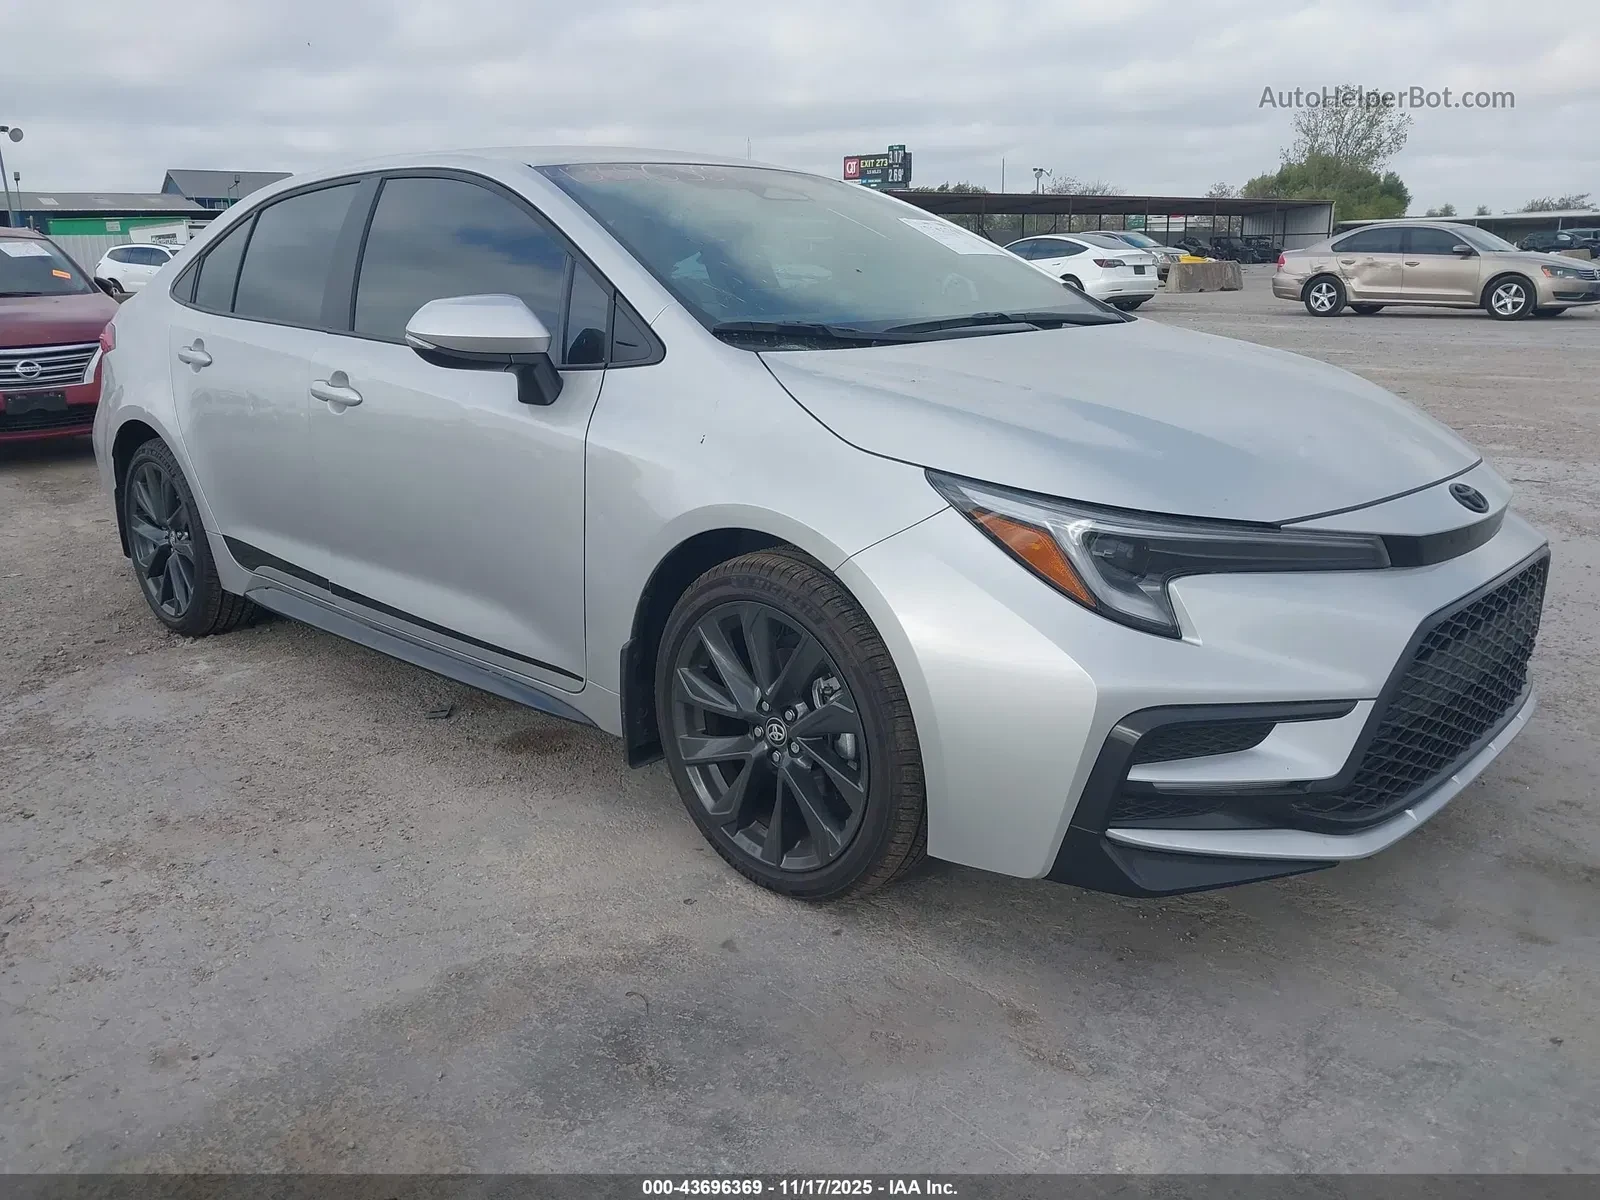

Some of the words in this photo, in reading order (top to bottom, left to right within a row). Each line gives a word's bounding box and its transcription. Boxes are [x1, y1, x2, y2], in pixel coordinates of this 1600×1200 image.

[846, 161, 857, 174] QT
[860, 160, 874, 168] EXIT
[876, 158, 888, 166] 273
